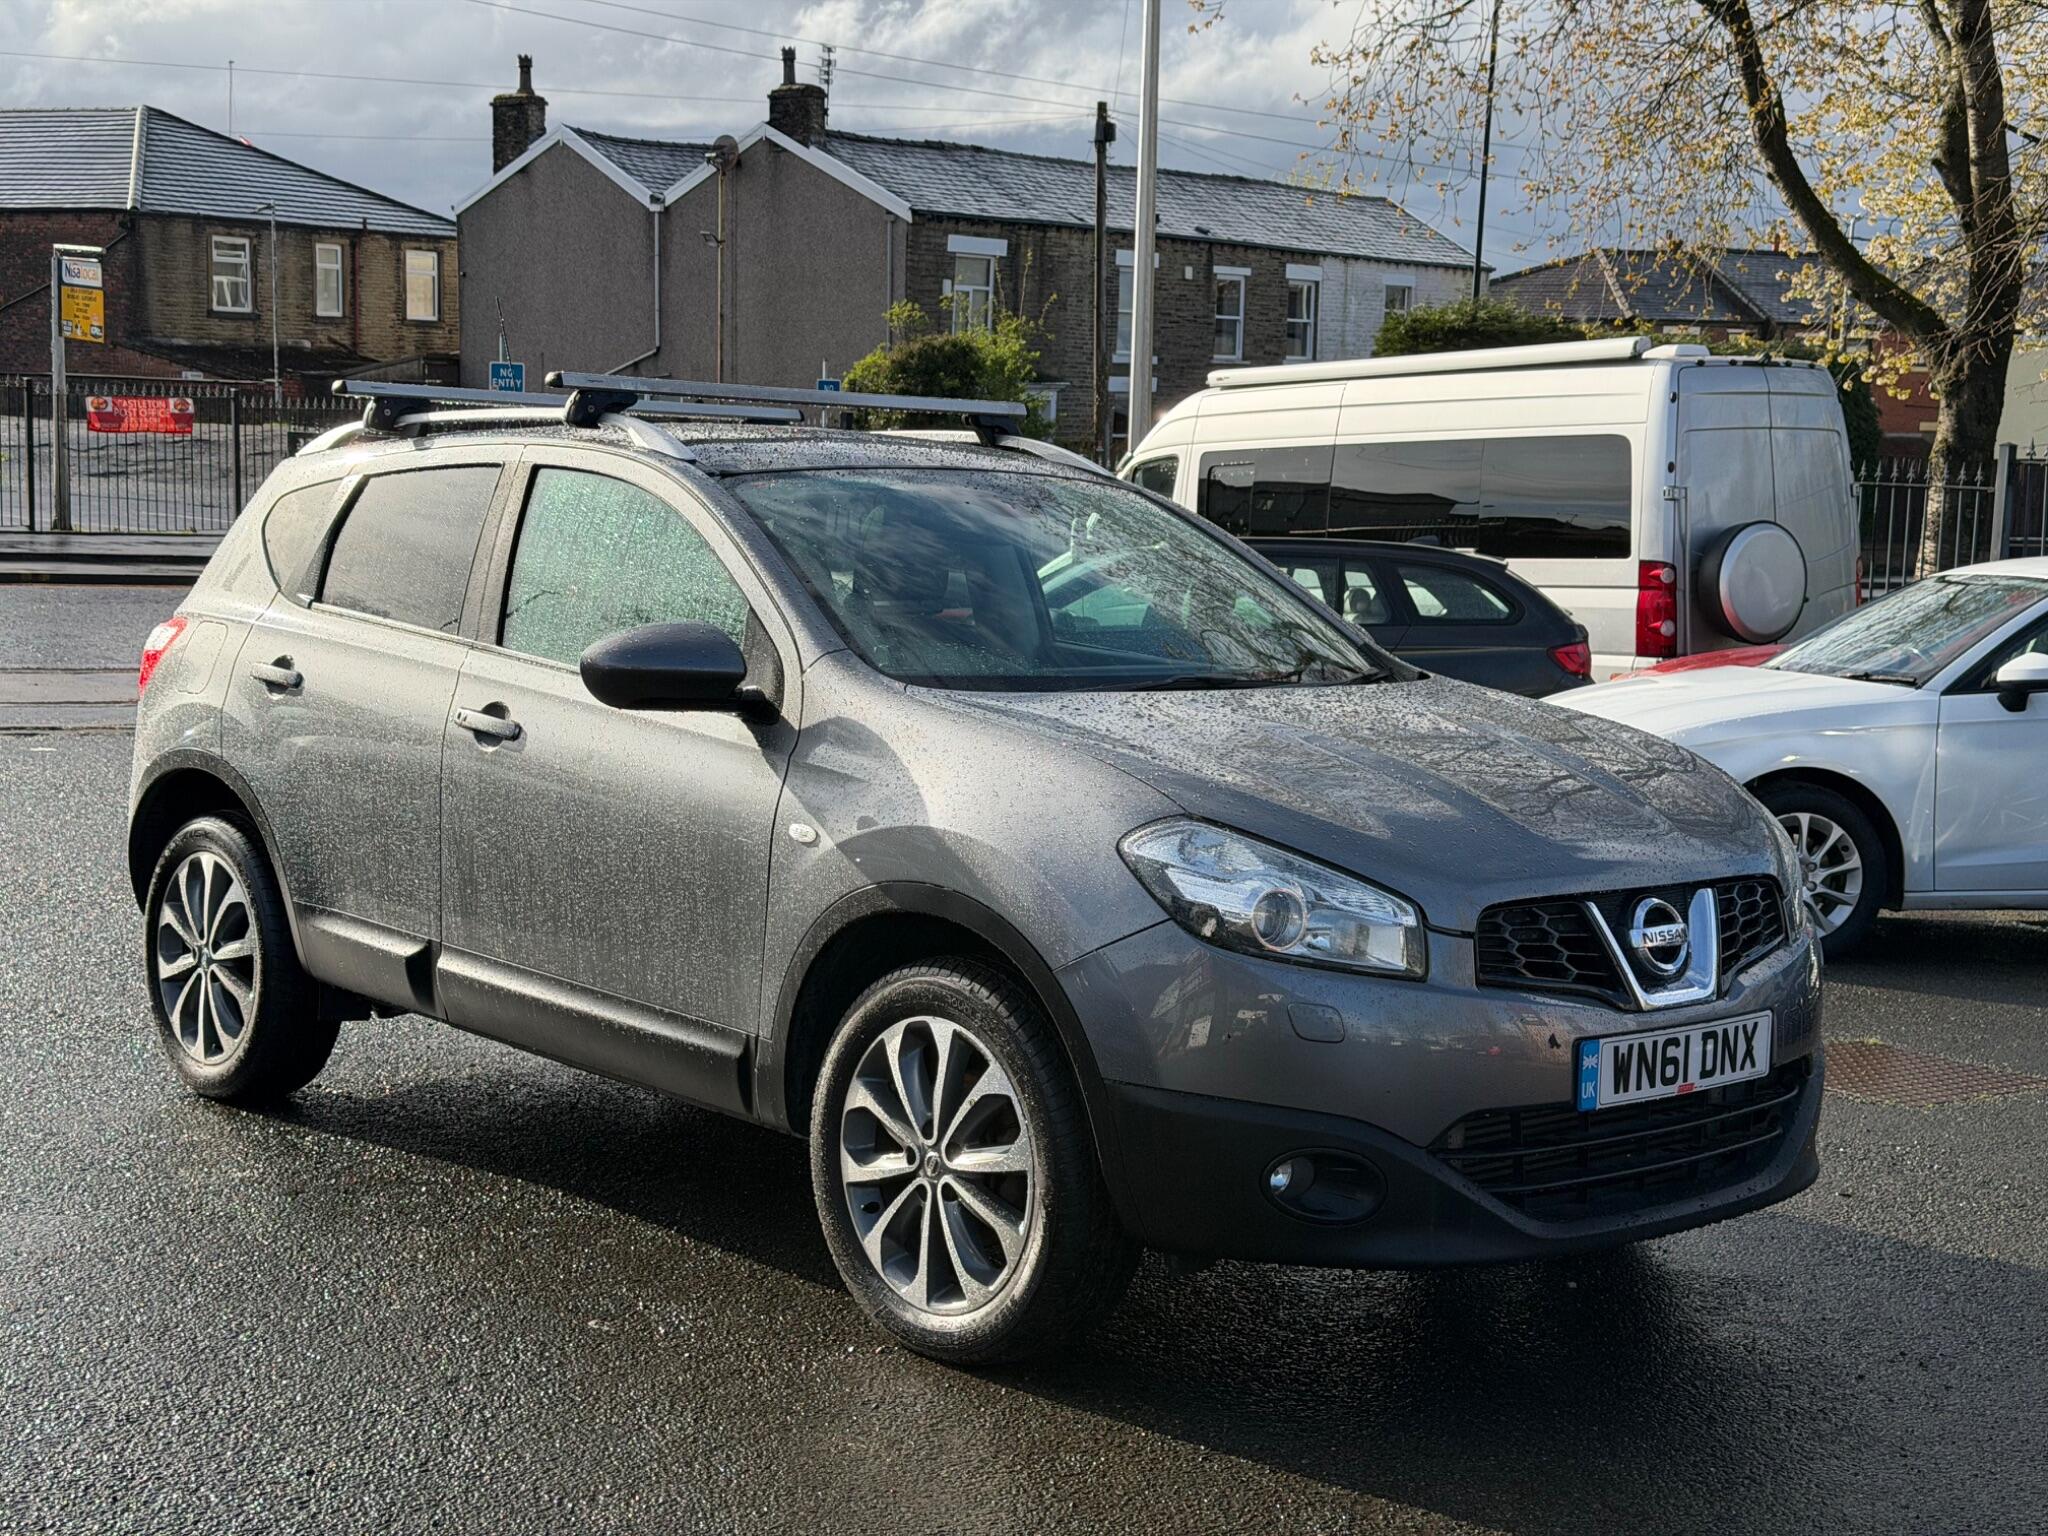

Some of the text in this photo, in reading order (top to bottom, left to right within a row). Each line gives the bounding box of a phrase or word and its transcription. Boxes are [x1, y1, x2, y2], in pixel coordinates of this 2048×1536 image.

[500, 367, 514, 378] NO
[492, 377, 522, 388] ENTRY
[113, 408, 136, 417] POST
[1642, 926, 1688, 945] NISSAN
[1613, 1021, 1759, 1095] WN61 DNX
[1581, 1081, 1596, 1099] UK
